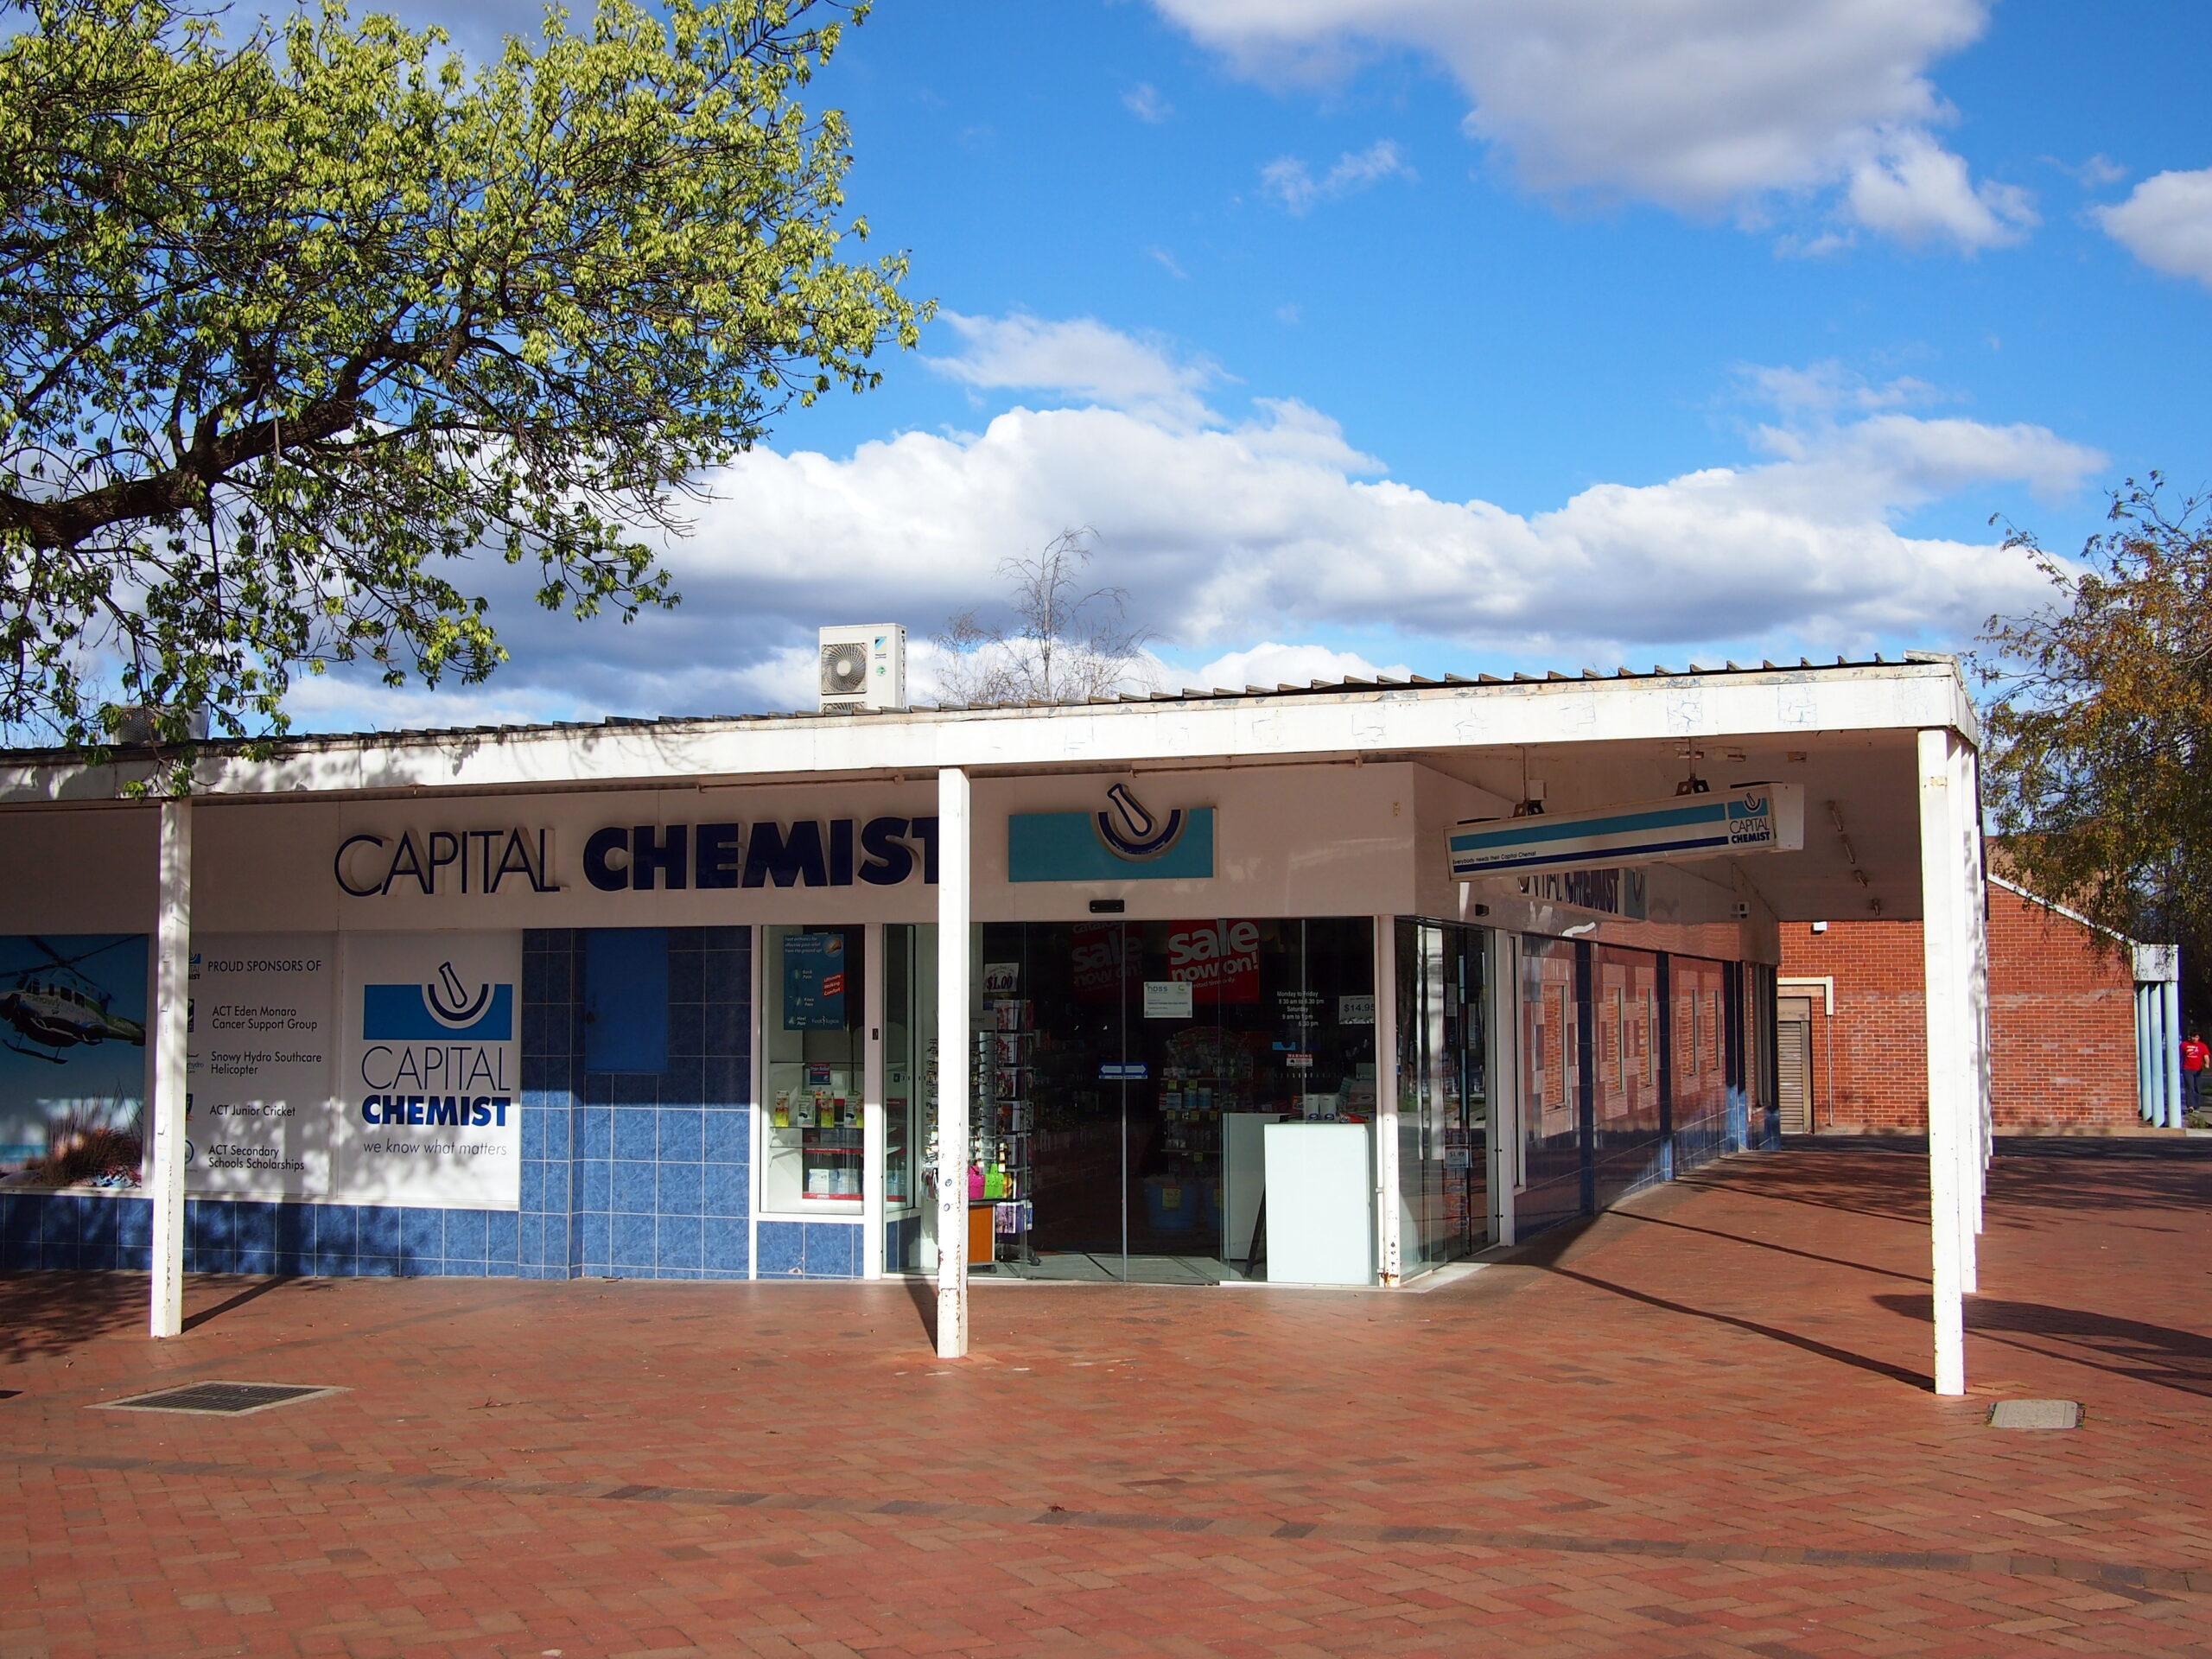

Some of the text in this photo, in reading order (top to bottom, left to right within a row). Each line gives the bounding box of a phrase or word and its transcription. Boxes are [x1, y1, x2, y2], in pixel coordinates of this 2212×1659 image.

[1730, 817, 1770, 834] CAPITAL
[1732, 831, 1770, 843] CHEMIST
[334, 817, 939, 896] CAPITAL CHEMIST
[1168, 918, 1259, 965] sale
[1071, 931, 1144, 972] sale
[208, 961, 244, 972] PROUD
[247, 960, 302, 972] SPONSORS
[307, 960, 321, 971] OF
[1171, 951, 1258, 982] now on!
[987, 975, 1013, 989] $1.00
[213, 1005, 296, 1016] ACT Eden Monaro
[1344, 1003, 1375, 1012] $14.95
[213, 1018, 317, 1032] Cancer Support Group
[211, 1051, 321, 1064] Snowy Hydro Southcare
[211, 1064, 258, 1076] Helicopter
[361, 1046, 511, 1091] CAPITAL
[210, 1105, 296, 1116] ACT Junior Cricket
[361, 1095, 511, 1127] CHEMIST
[208, 1145, 279, 1159] ACT Secondary
[364, 1138, 506, 1155] we know what matters
[208, 1157, 304, 1172] Schools Scholarships
